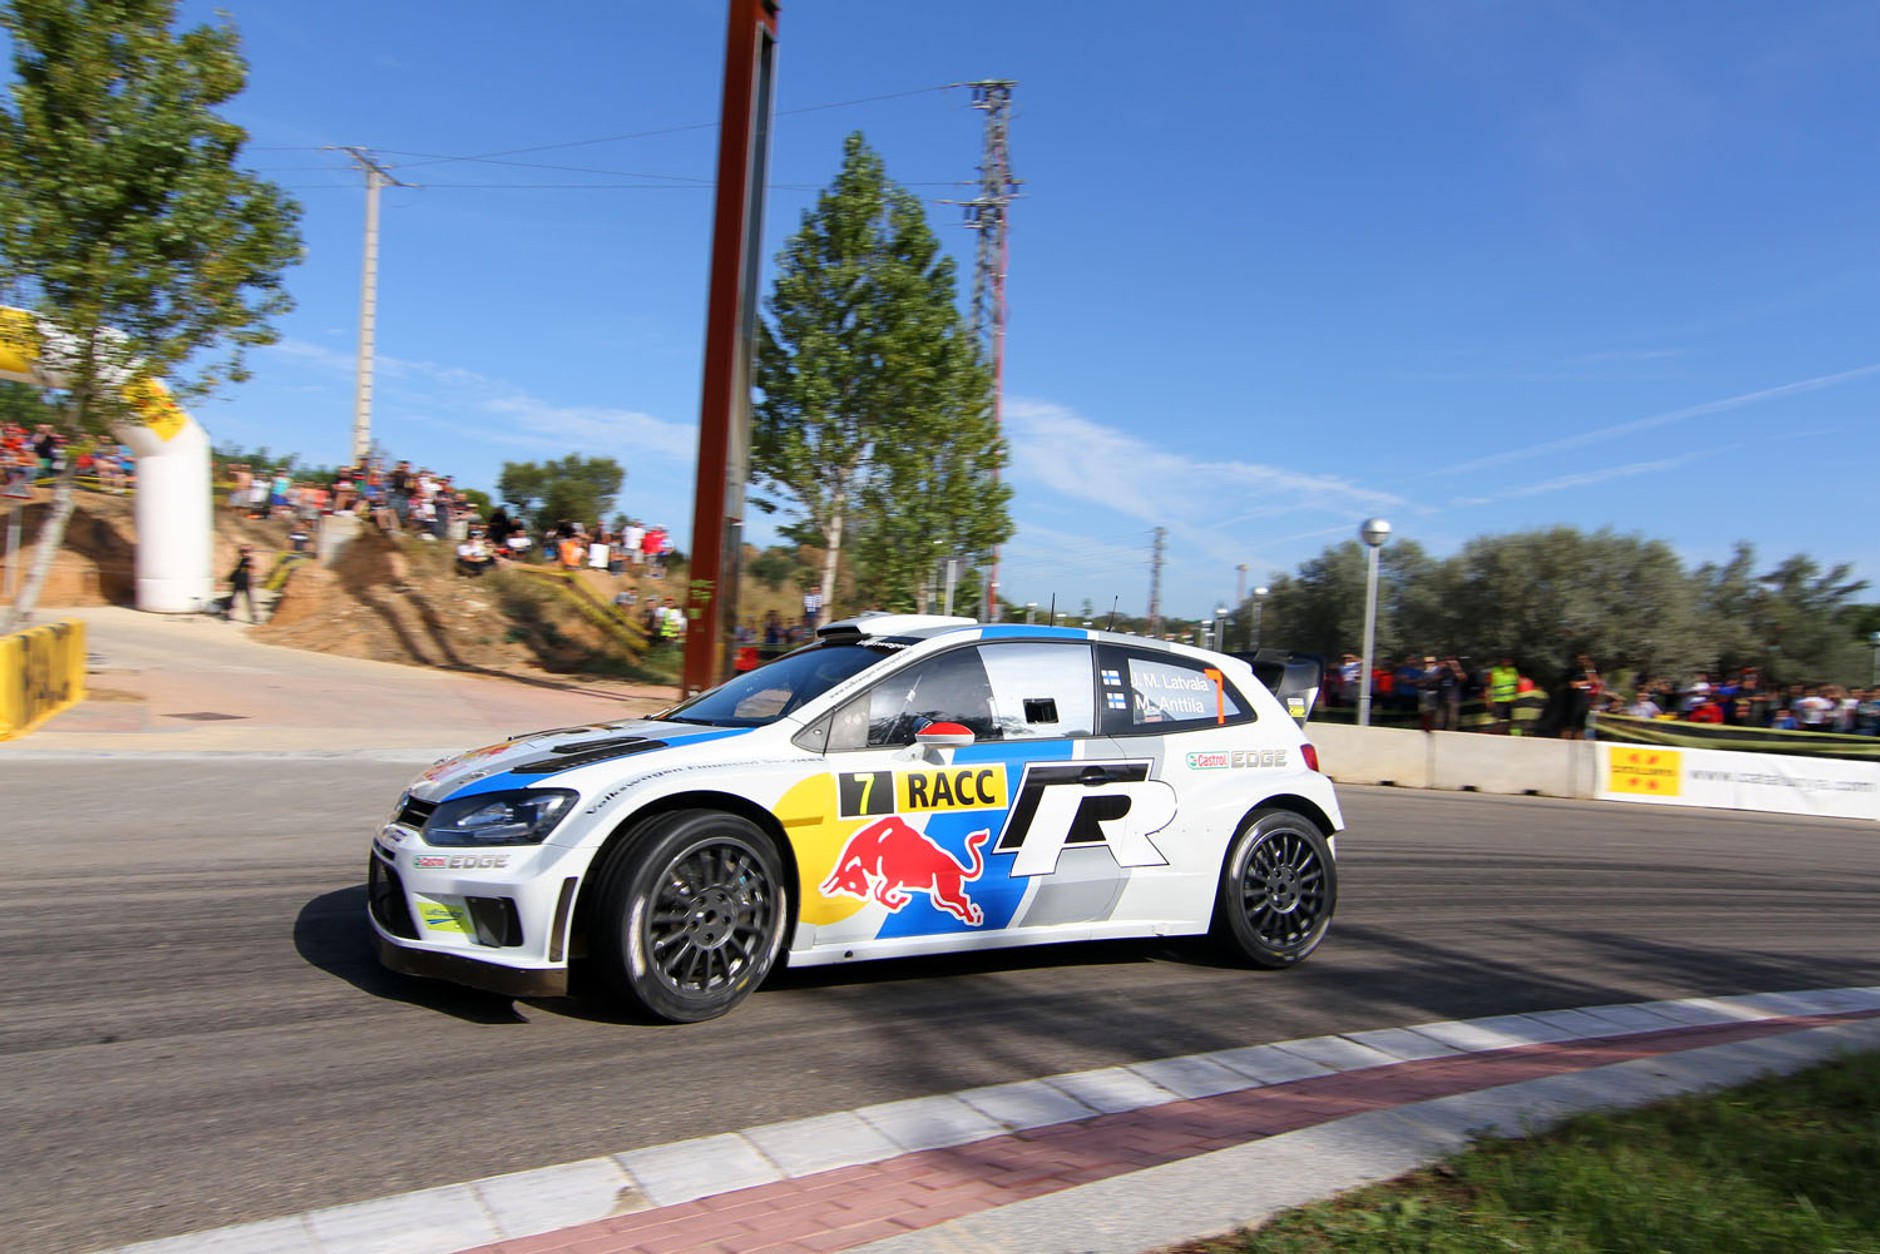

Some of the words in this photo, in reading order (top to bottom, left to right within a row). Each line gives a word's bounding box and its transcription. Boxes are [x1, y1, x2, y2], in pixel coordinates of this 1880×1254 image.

[1162, 674, 1210, 692] Latvala
[1203, 667, 1226, 725] 7
[1134, 694, 1155, 711] M.
[1159, 696, 1205, 713] Anttila
[1197, 753, 1228, 767] Castrol
[1230, 749, 1287, 769] EDGE
[853, 772, 876, 815] 7
[908, 769, 995, 809] RACC
[991, 757, 1178, 879] R
[448, 854, 512, 869] EDGE
